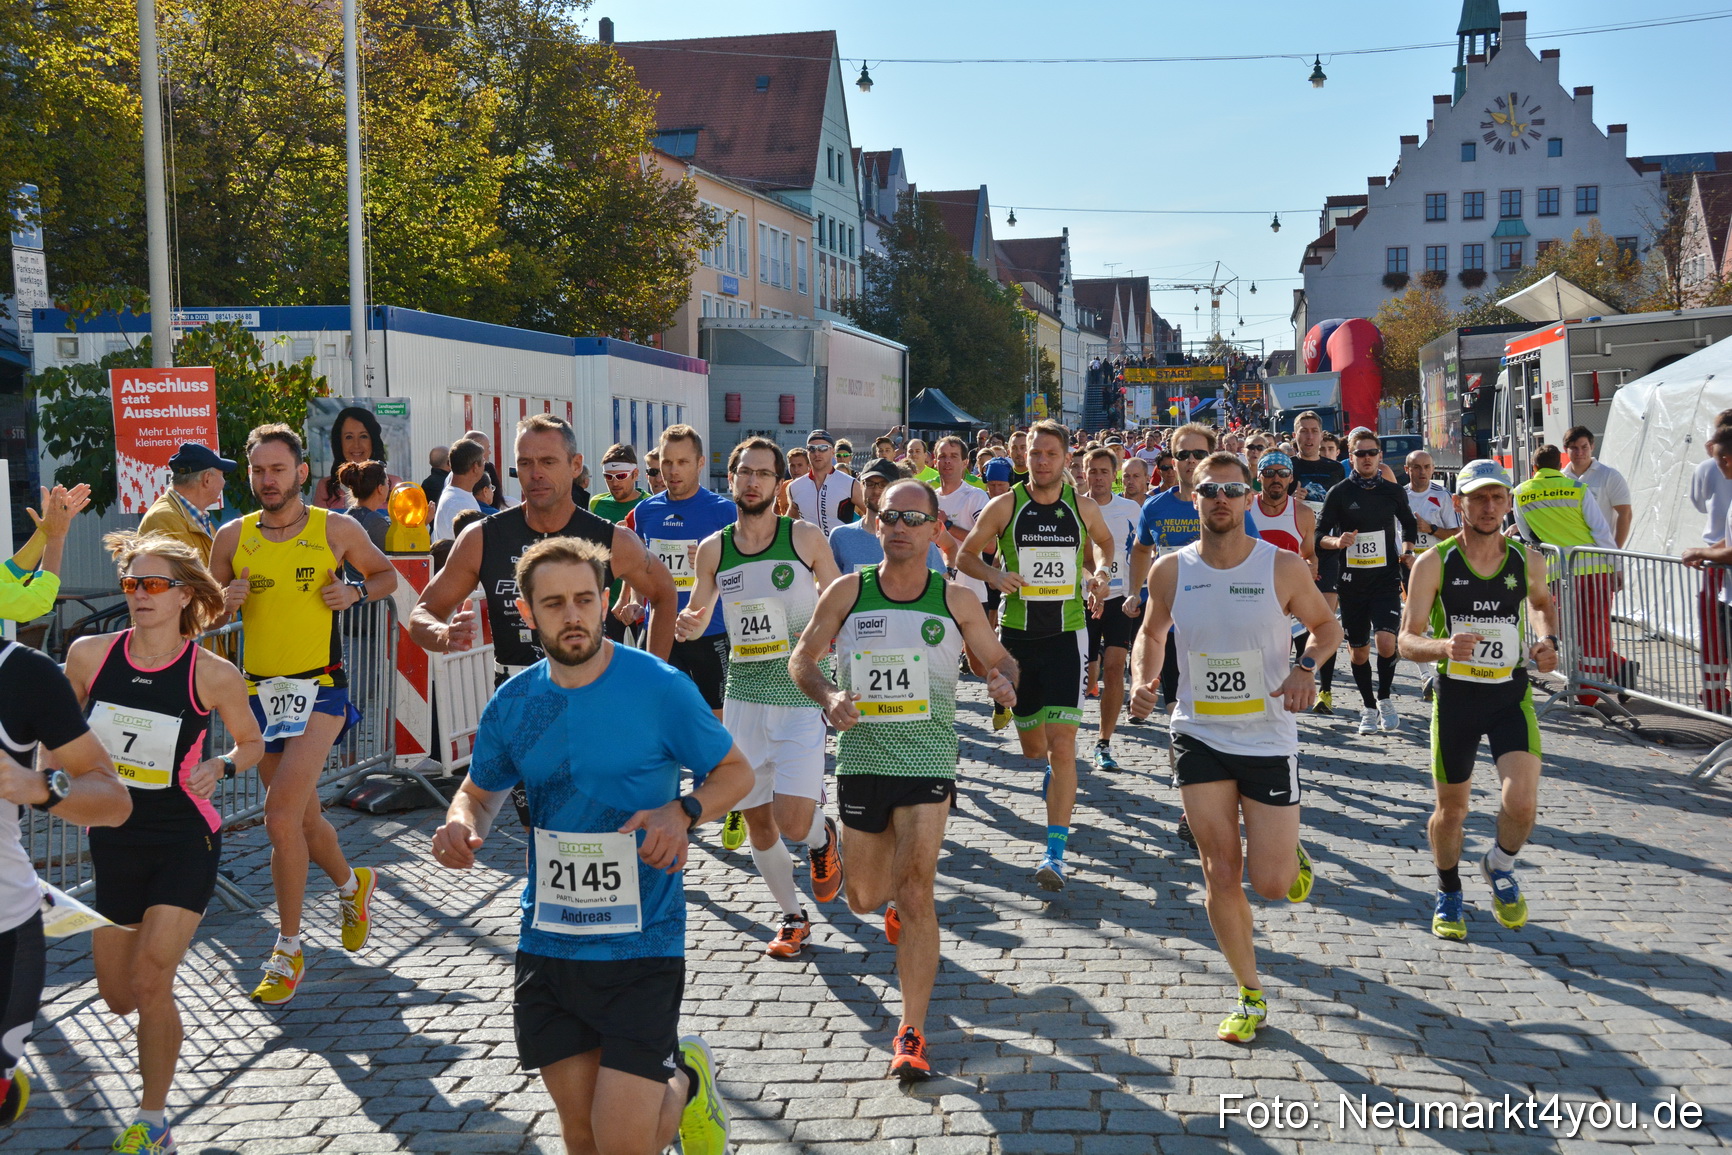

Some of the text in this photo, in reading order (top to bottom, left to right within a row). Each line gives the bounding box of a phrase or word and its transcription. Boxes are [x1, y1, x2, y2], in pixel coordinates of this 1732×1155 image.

[16, 264, 44, 276] Parkschein
[20, 274, 43, 288] werktags
[1156, 370, 1192, 379] START
[121, 378, 209, 394] Abschluss
[121, 394, 150, 404] statt
[123, 405, 210, 419] Ausschluss!
[138, 426, 208, 436] Mehr Lehrer für
[136, 437, 209, 447] kleinere Klassen.
[1521, 489, 1574, 502] Org.-Leiter
[1022, 534, 1074, 542] Röthenbach
[1416, 534, 1427, 544] 13
[1356, 542, 1376, 554] 183
[296, 567, 315, 579] MTP
[1033, 562, 1064, 578] 243
[1111, 562, 1118, 573] 8
[1342, 572, 1352, 582] 44
[1229, 586, 1265, 595] Kneitinger
[741, 603, 765, 611] BOCK
[1473, 601, 1500, 611] DAV
[1450, 614, 1516, 623] Röthenbach
[741, 615, 771, 635] 244
[740, 644, 779, 655] Christopher
[1472, 641, 1503, 659] 78
[872, 655, 904, 663] BOCK
[1208, 658, 1240, 666] BOCK
[1471, 668, 1494, 678] Ralph
[869, 668, 910, 691] 214
[1206, 671, 1246, 692] 328
[270, 694, 307, 715] 2179
[878, 704, 904, 714] Klaus
[113, 713, 153, 728] BOCK
[1048, 710, 1080, 720] tritea
[122, 731, 138, 753] 7
[121, 756, 146, 766] Neumarkt
[117, 765, 136, 777] Eva
[558, 841, 604, 854] BOCK
[549, 859, 621, 891] 2145
[556, 894, 574, 903] PARTL
[561, 908, 612, 923] Andreas
